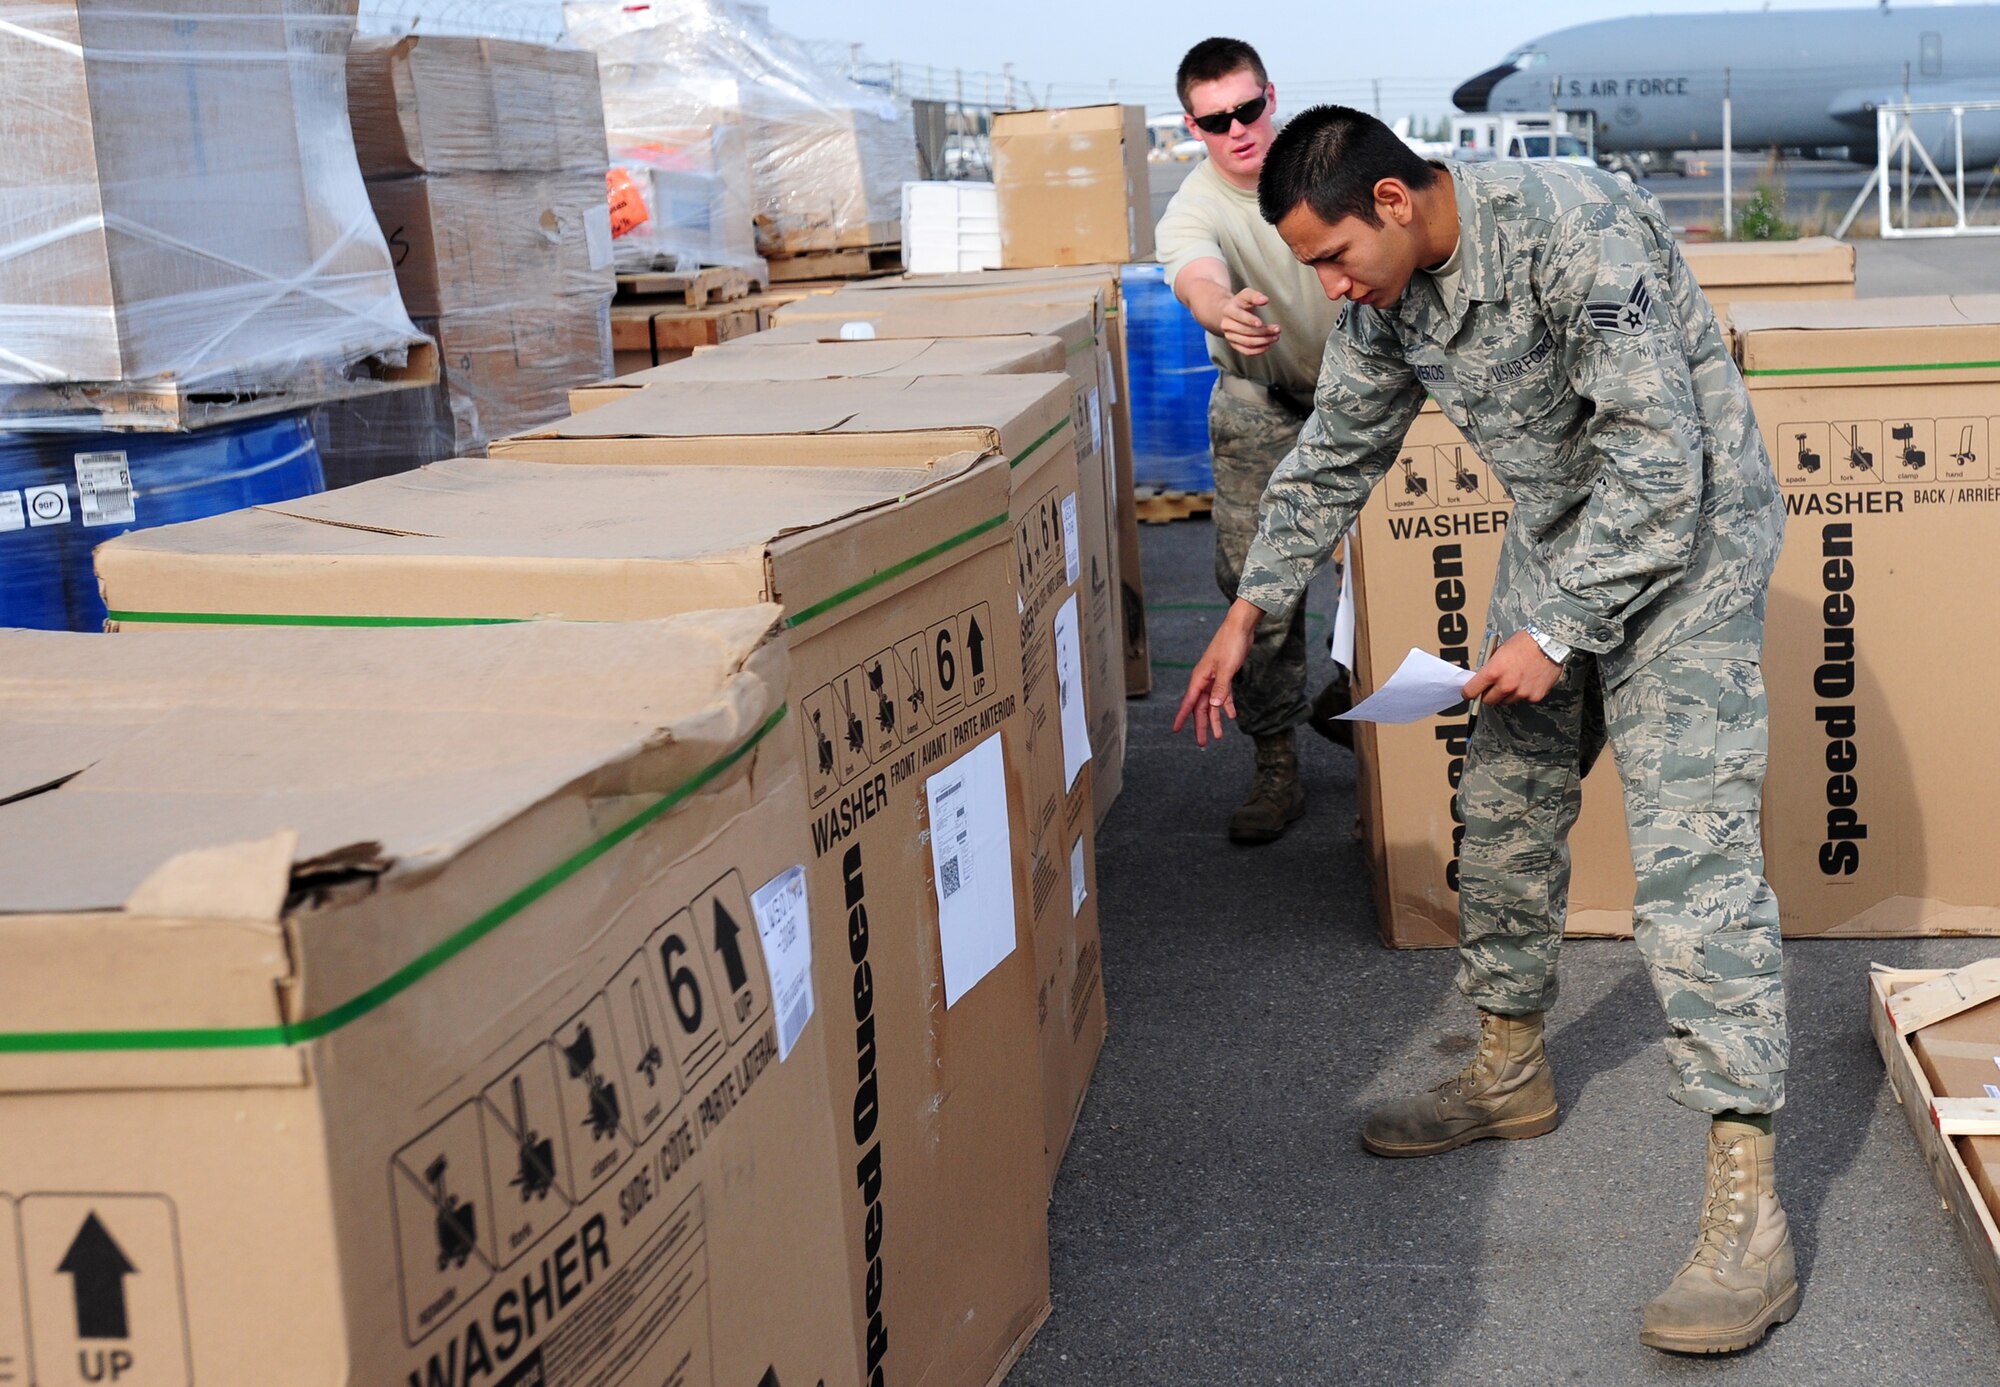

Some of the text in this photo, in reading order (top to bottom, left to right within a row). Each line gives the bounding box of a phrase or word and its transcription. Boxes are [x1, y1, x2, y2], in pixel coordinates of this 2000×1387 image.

[1591, 78, 1618, 98] AIR
[1625, 77, 1689, 97] FORCE
[1491, 331, 1556, 383] U.S. AIR FORC
[1785, 476, 1807, 484] spade
[1898, 473, 1919, 481] clamp
[1393, 500, 1415, 508] spade
[1781, 491, 1904, 516] WASHER
[1914, 489, 1946, 504] BACK
[1040, 503, 1049, 551] 6
[1388, 511, 1509, 541] WASHER
[935, 628, 956, 692] 6
[973, 676, 986, 697] UP
[1813, 523, 1868, 876] Speed Queen
[811, 772, 889, 859] WASHER
[890, 757, 916, 788] FRONT
[922, 733, 947, 768] AVANT
[954, 720, 979, 749] PARTE
[979, 693, 1017, 732] ANTERIOR
[660, 934, 704, 1035] 6
[734, 989, 754, 1024] UP
[842, 842, 888, 1387] peed Queen
[618, 1164, 653, 1229] SIDE
[697, 1073, 738, 1140] PARTE
[78, 1349, 134, 1383] UP
